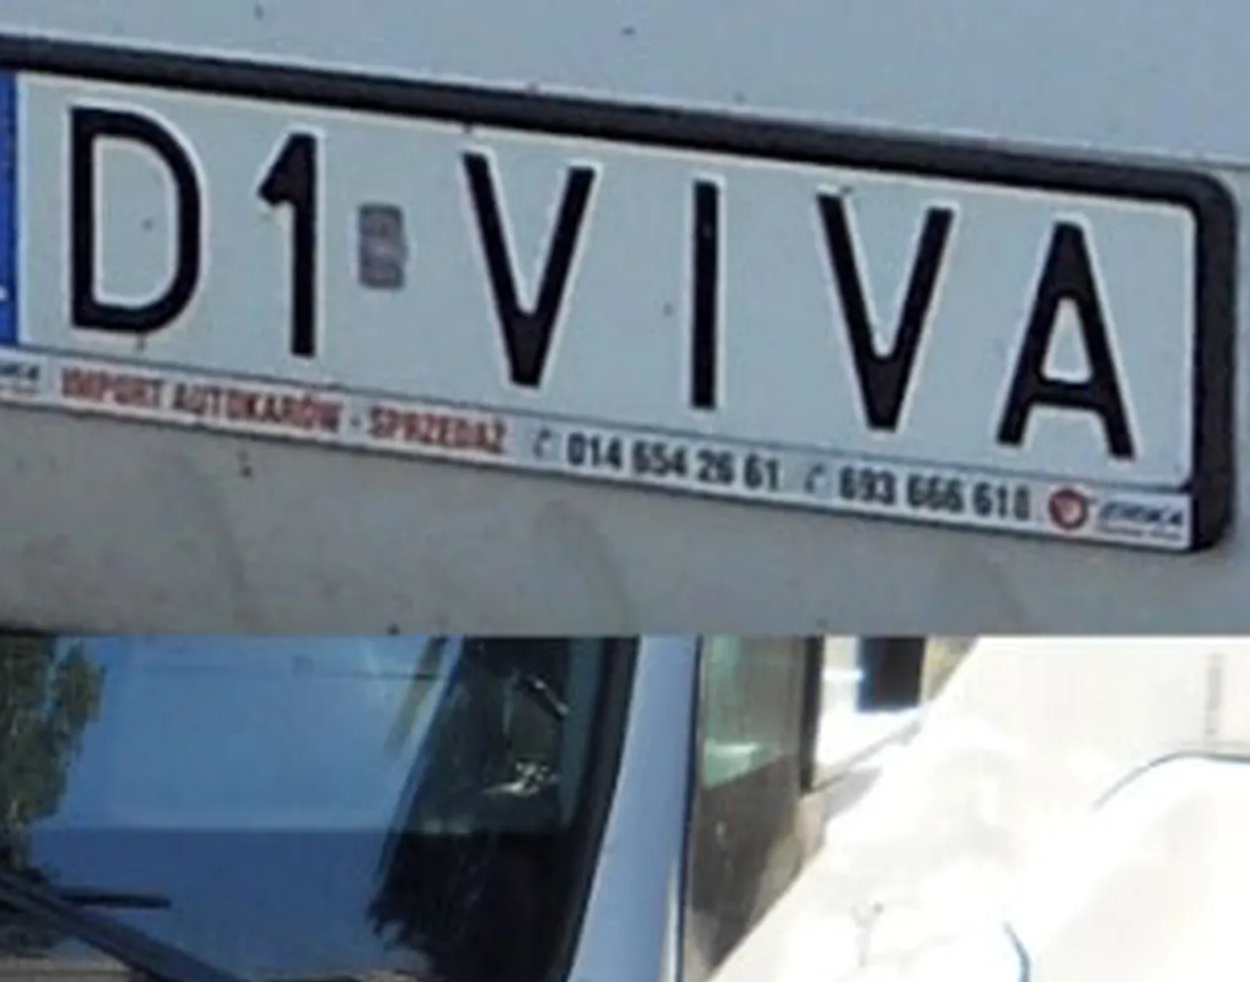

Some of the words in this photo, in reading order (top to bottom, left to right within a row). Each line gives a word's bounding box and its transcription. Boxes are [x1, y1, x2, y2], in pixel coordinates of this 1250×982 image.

[70, 107, 318, 359] D1
[464, 151, 1133, 457] VIVA
[61, 366, 165, 408] IMPORT
[567, 433, 622, 469] 014
[744, 453, 780, 491] 61
